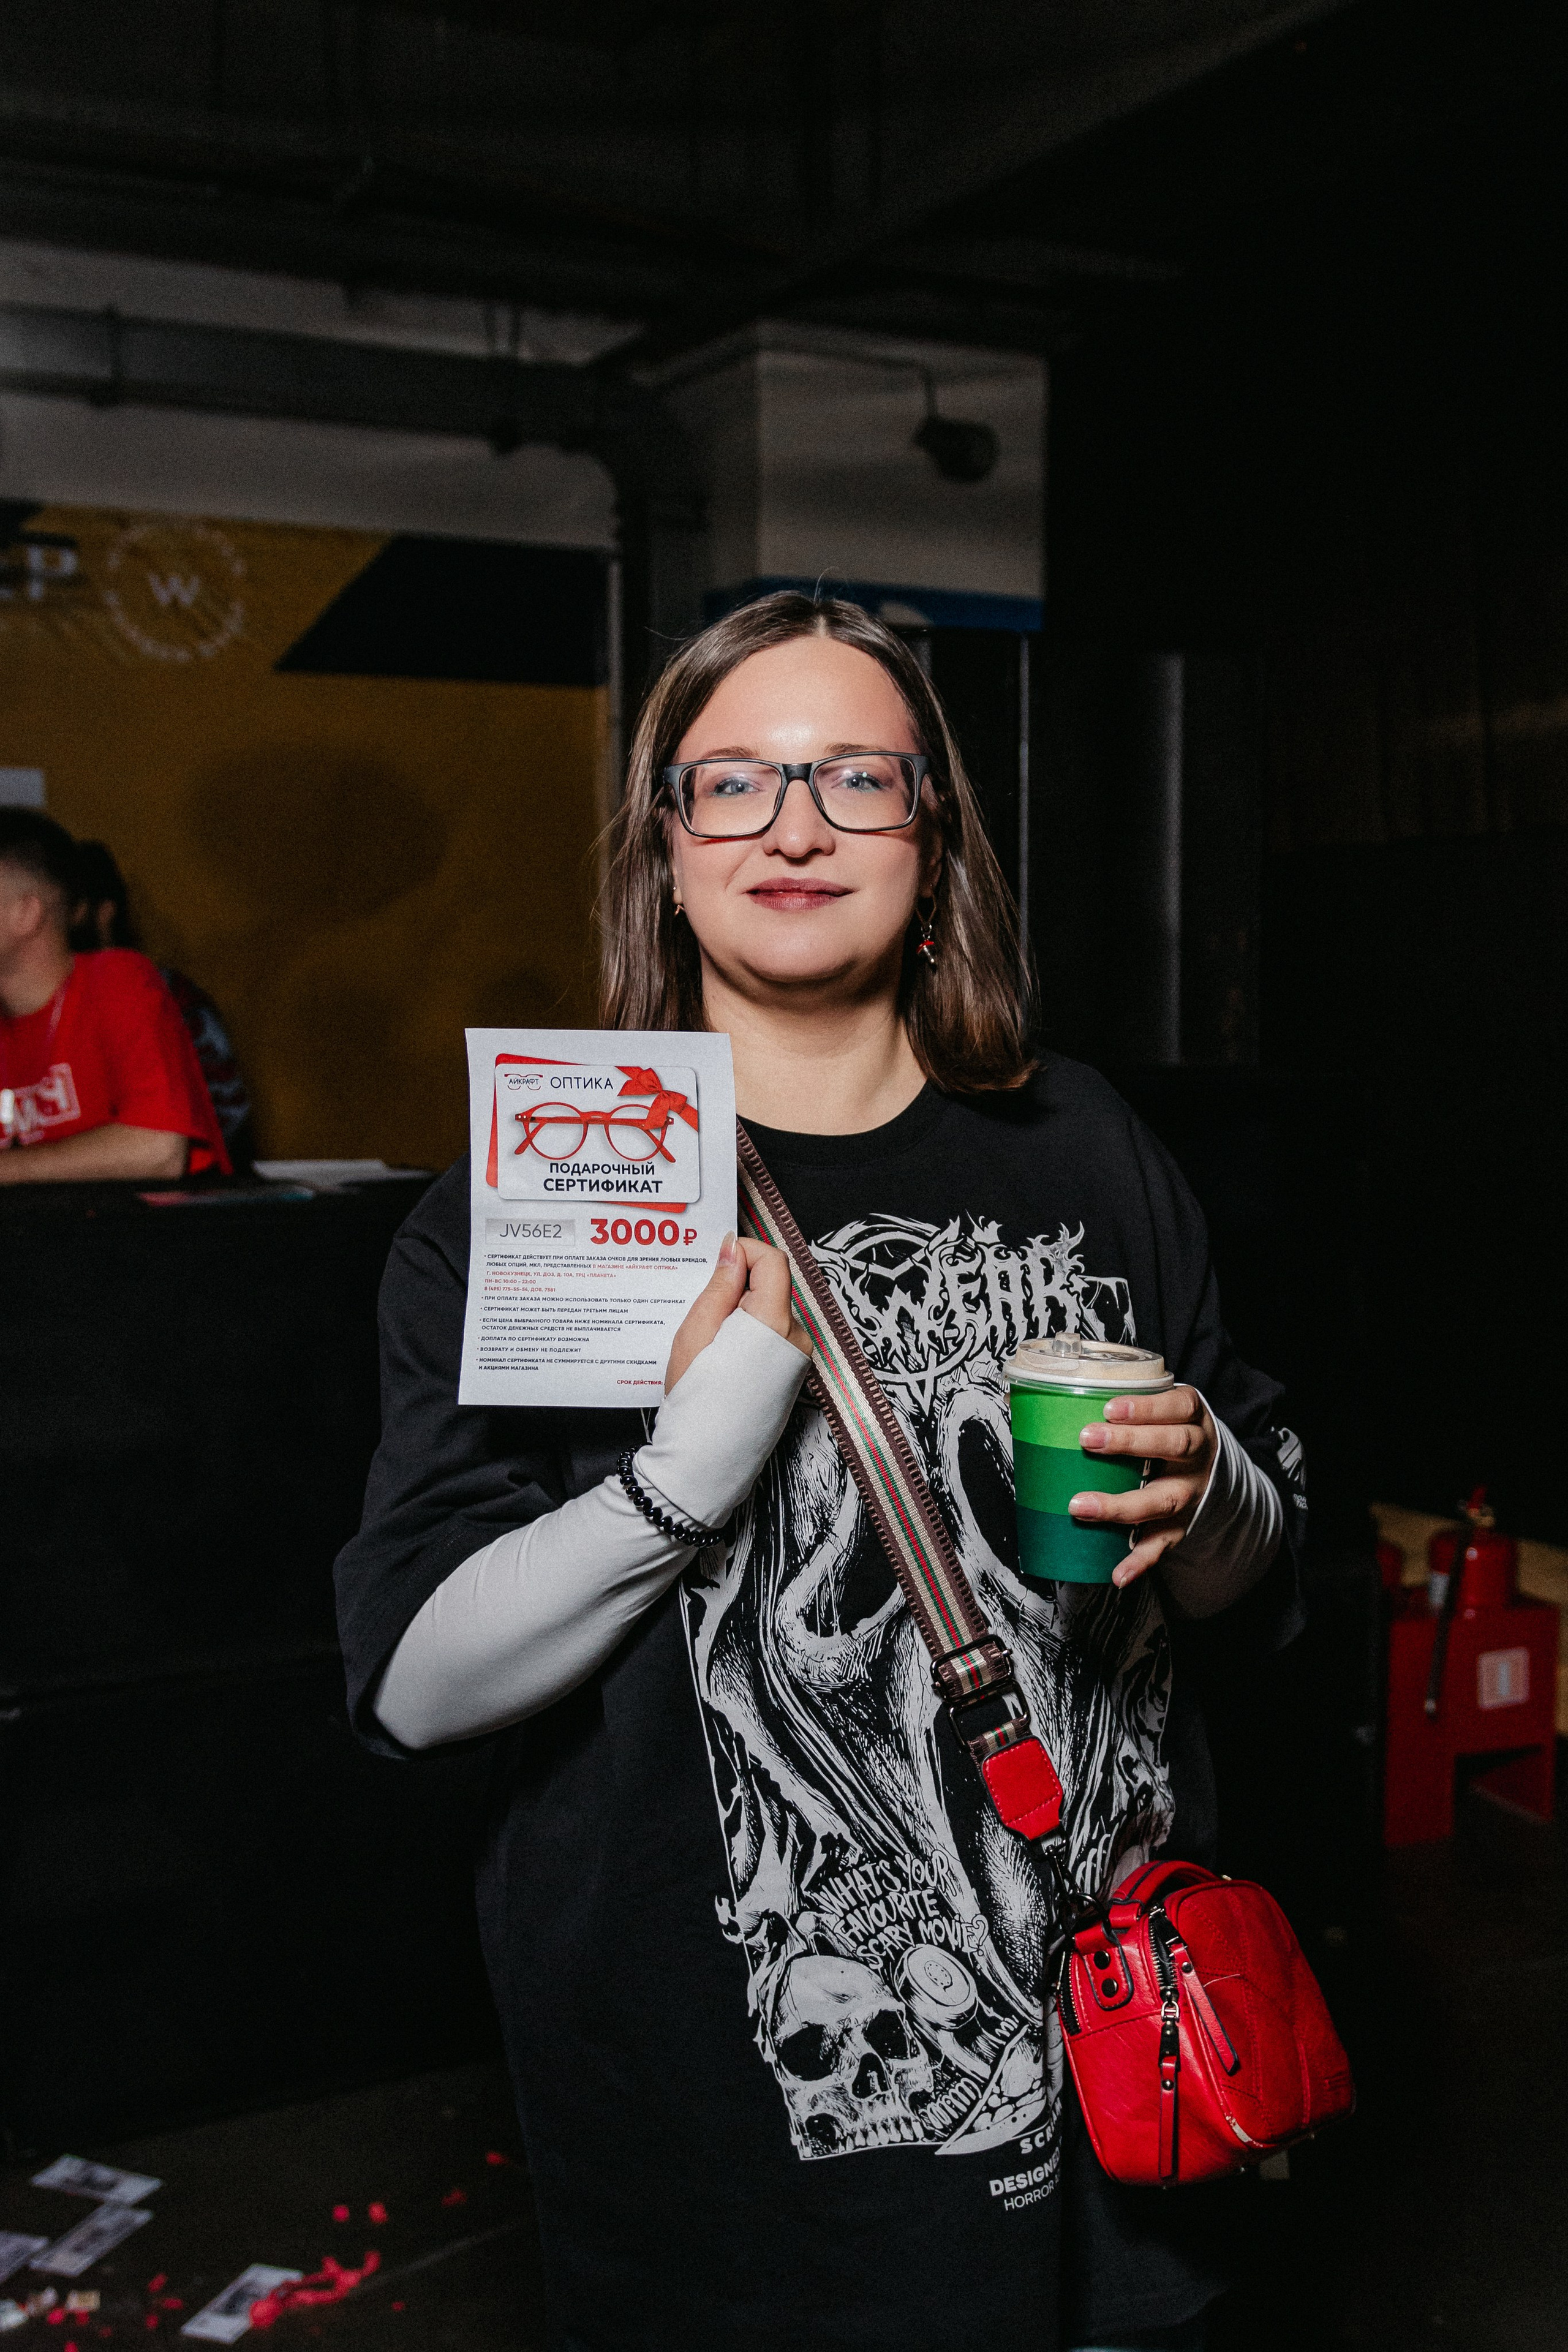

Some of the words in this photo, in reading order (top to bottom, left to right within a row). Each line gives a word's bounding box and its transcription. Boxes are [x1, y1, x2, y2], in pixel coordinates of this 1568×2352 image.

[508, 1077, 539, 1085] АЙКРАФТ
[551, 1076, 613, 1090] ОПТИКА
[549, 1161, 655, 1175] ПОДАРОЧНЫЙ
[543, 1178, 663, 1193] СЕРТИФИКАТ
[499, 1224, 562, 1238] JV56E2
[895, 1850, 957, 1897] YOUR
[856, 1921, 917, 1970] SCARY
[1004, 2180, 1055, 2211] HORROR
